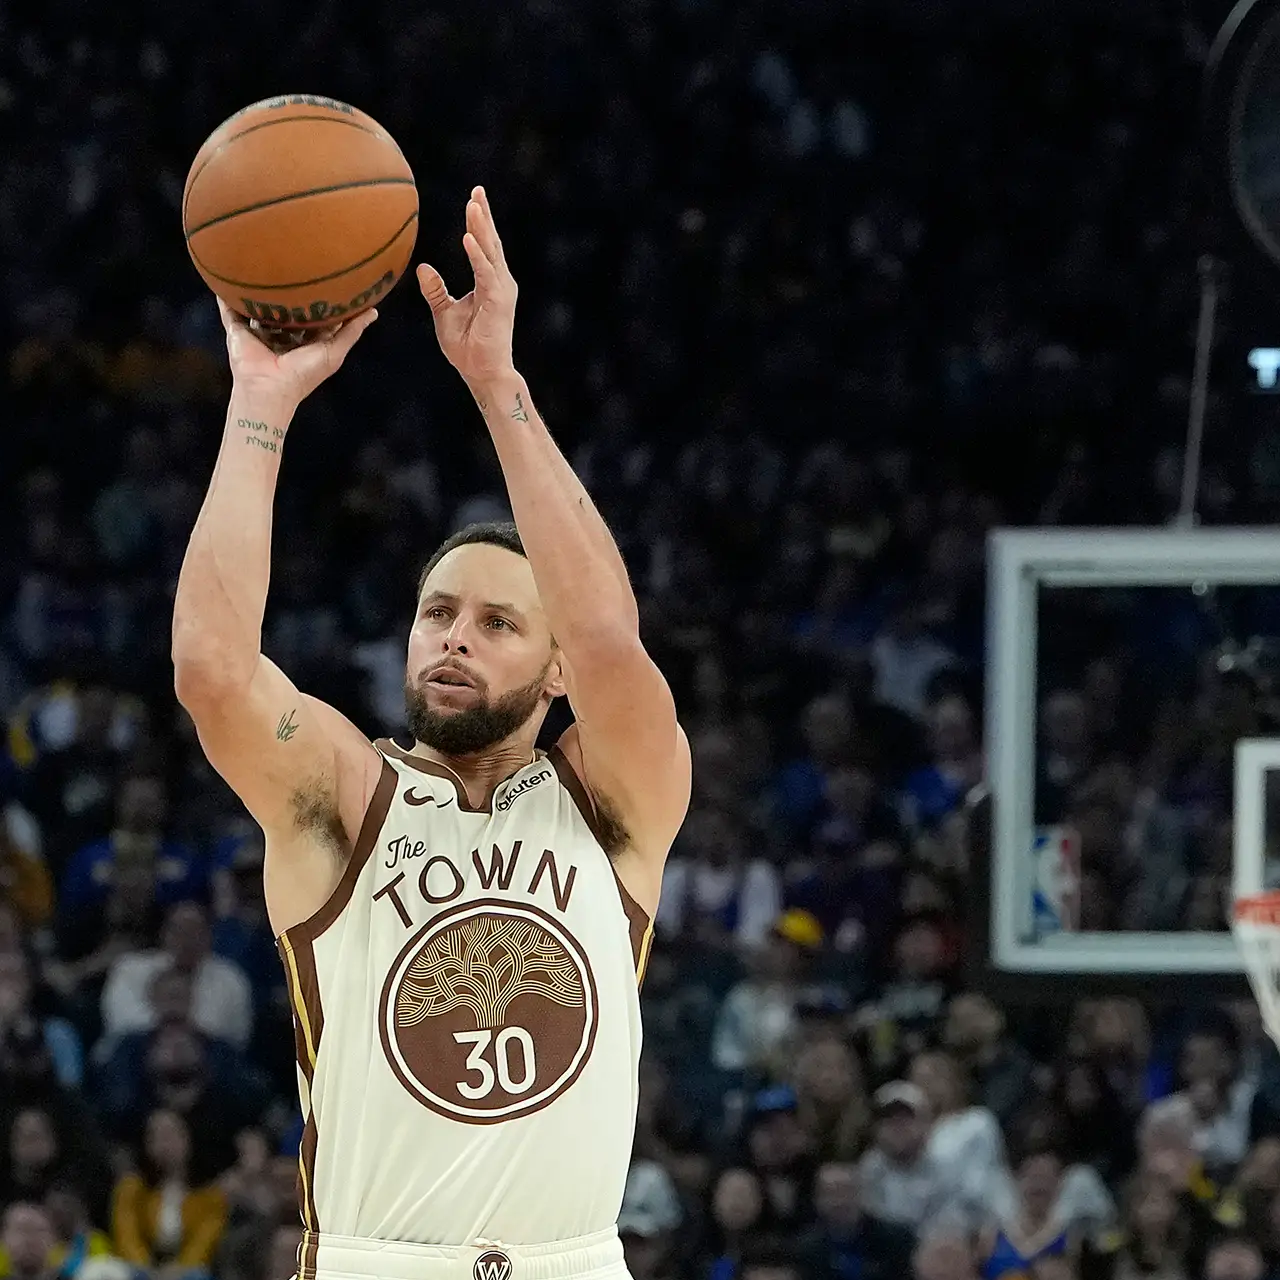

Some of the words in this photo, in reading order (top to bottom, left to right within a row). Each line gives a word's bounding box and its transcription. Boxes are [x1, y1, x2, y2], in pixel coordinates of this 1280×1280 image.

[372, 840, 578, 929] TOWN
[385, 834, 427, 869] The
[452, 1026, 536, 1100] 30
